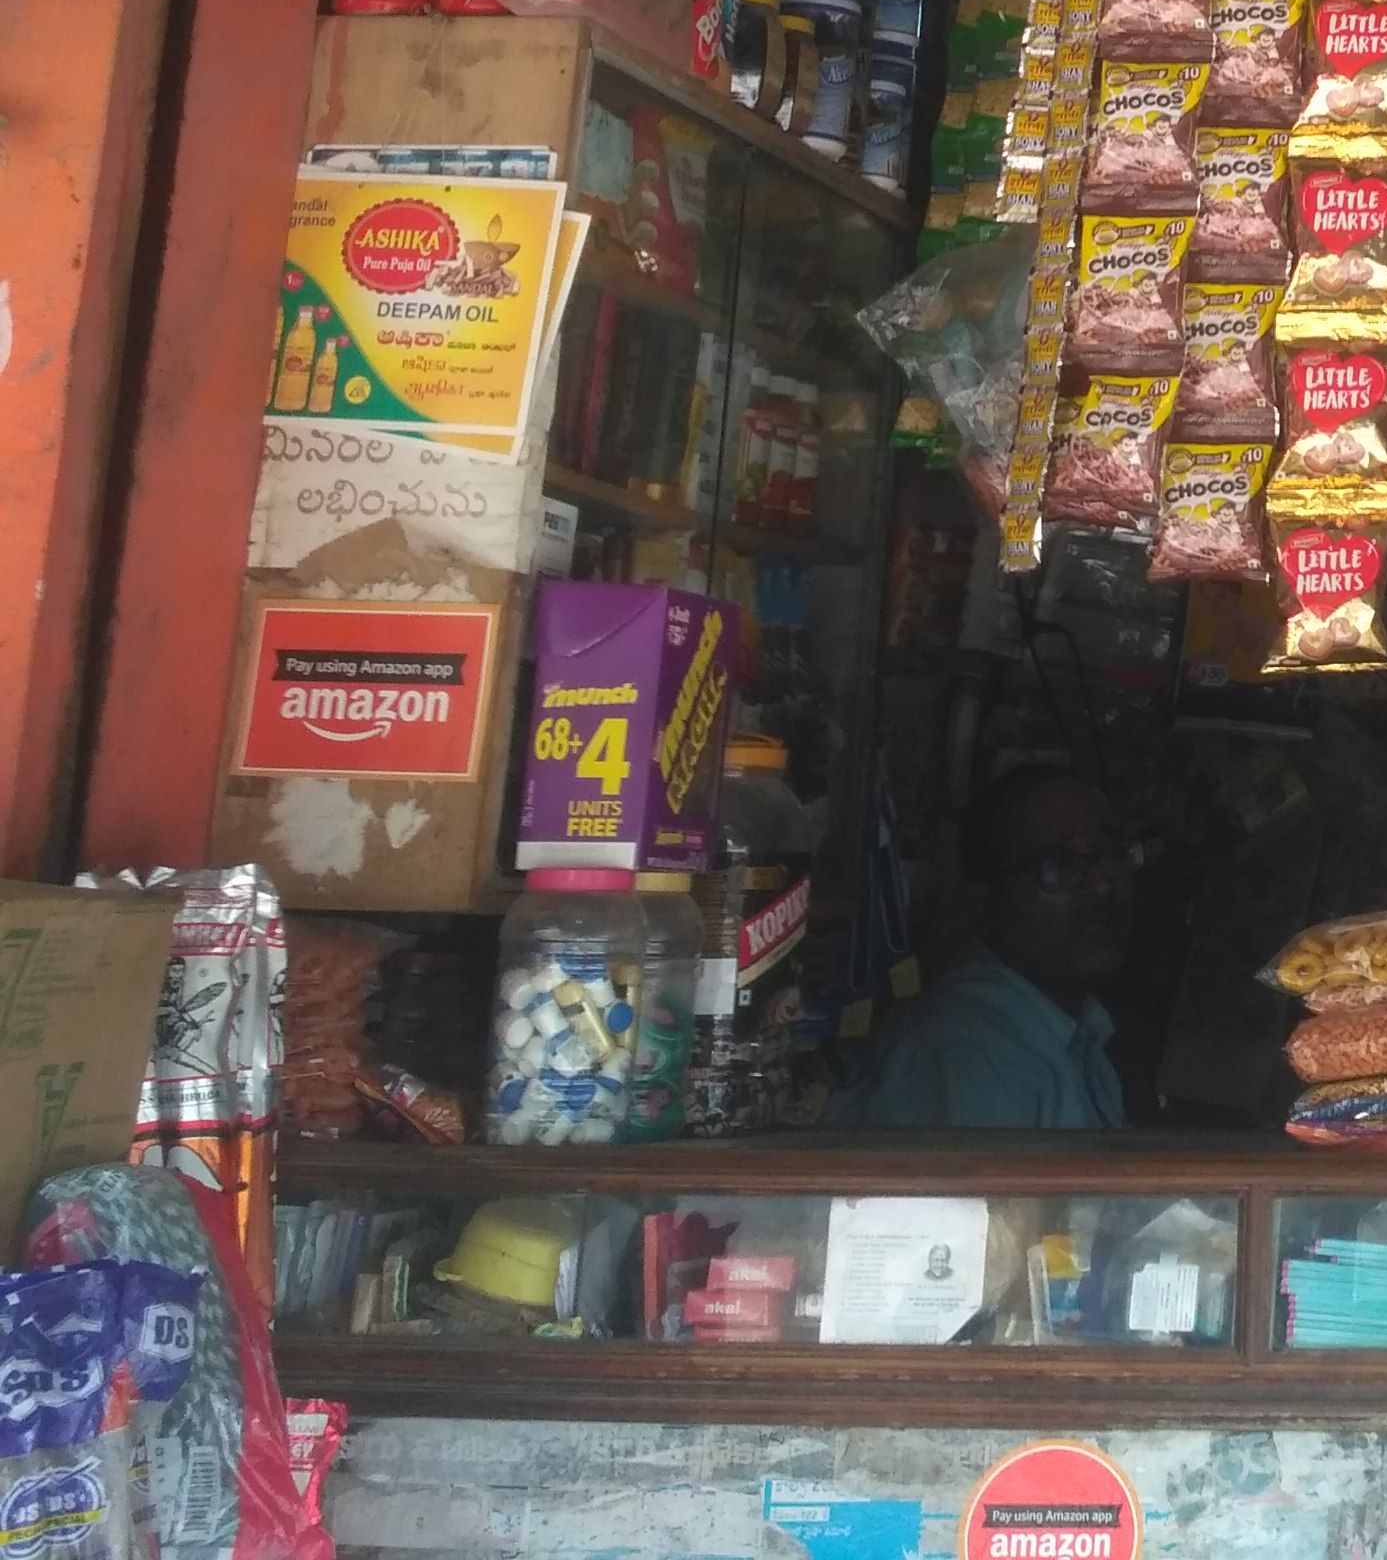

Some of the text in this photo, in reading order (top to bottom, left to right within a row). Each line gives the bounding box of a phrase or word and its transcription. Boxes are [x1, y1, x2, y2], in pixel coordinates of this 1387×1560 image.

[1102, 88, 1184, 115] CHOCOS
[1315, 188, 1379, 211] LITTLE
[1313, 211, 1383, 232] HEARTS
[356, 228, 441, 256] ASHIKA
[363, 257, 432, 273] Pure Puja Oil
[1088, 248, 1170, 273] CHOCOS
[377, 300, 500, 323] DEEPAM OIL
[1305, 366, 1371, 389] LITTLE
[1302, 389, 1371, 411] HEARTS
[1165, 475, 1248, 501] CHOCOS
[1297, 549, 1362, 572] LITTLE
[1296, 571, 1364, 595] HEARTS
[285, 657, 454, 680] Pay using Amazon app
[281, 686, 450, 724] amazon
[576, 718, 630, 796] 4
[568, 800, 623, 817] UNITS
[567, 818, 619, 838] FREE
[992, 1509, 1112, 1525] Pay using Amazon app
[990, 1532, 1112, 1559] amazon
